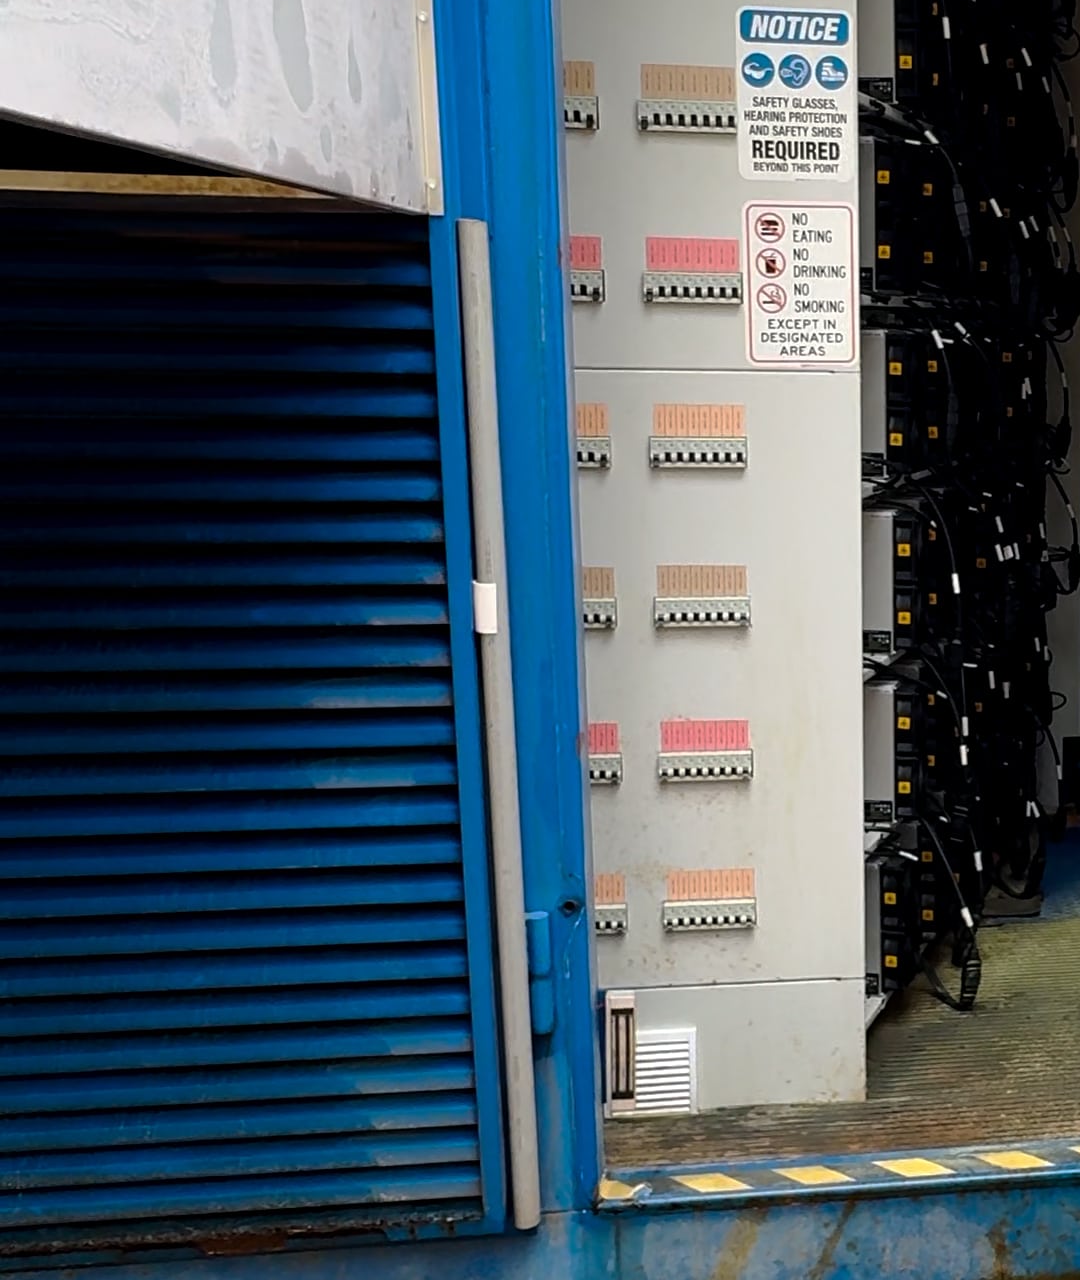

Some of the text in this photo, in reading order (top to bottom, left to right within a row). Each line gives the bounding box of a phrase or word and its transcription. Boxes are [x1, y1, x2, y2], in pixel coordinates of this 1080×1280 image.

[750, 14, 841, 41] NOTICE
[752, 96, 838, 111] SAFETY GLASSES,
[744, 111, 847, 124] HEARING PROTECTION
[749, 125, 842, 138] AND SAFETY SHOES
[752, 140, 840, 161] REQUIRED
[754, 162, 839, 173] BEYOND THIS POINT
[792, 213, 808, 226] NO
[793, 230, 832, 243] EATING
[793, 248, 809, 261] NO
[793, 266, 846, 279] DRINKING
[794, 284, 809, 296] NO
[795, 300, 844, 313] SMOKING
[768, 319, 836, 329] EXCEPT IN
[761, 332, 843, 343] DESIGNATED
[780, 346, 826, 356] AREAS
